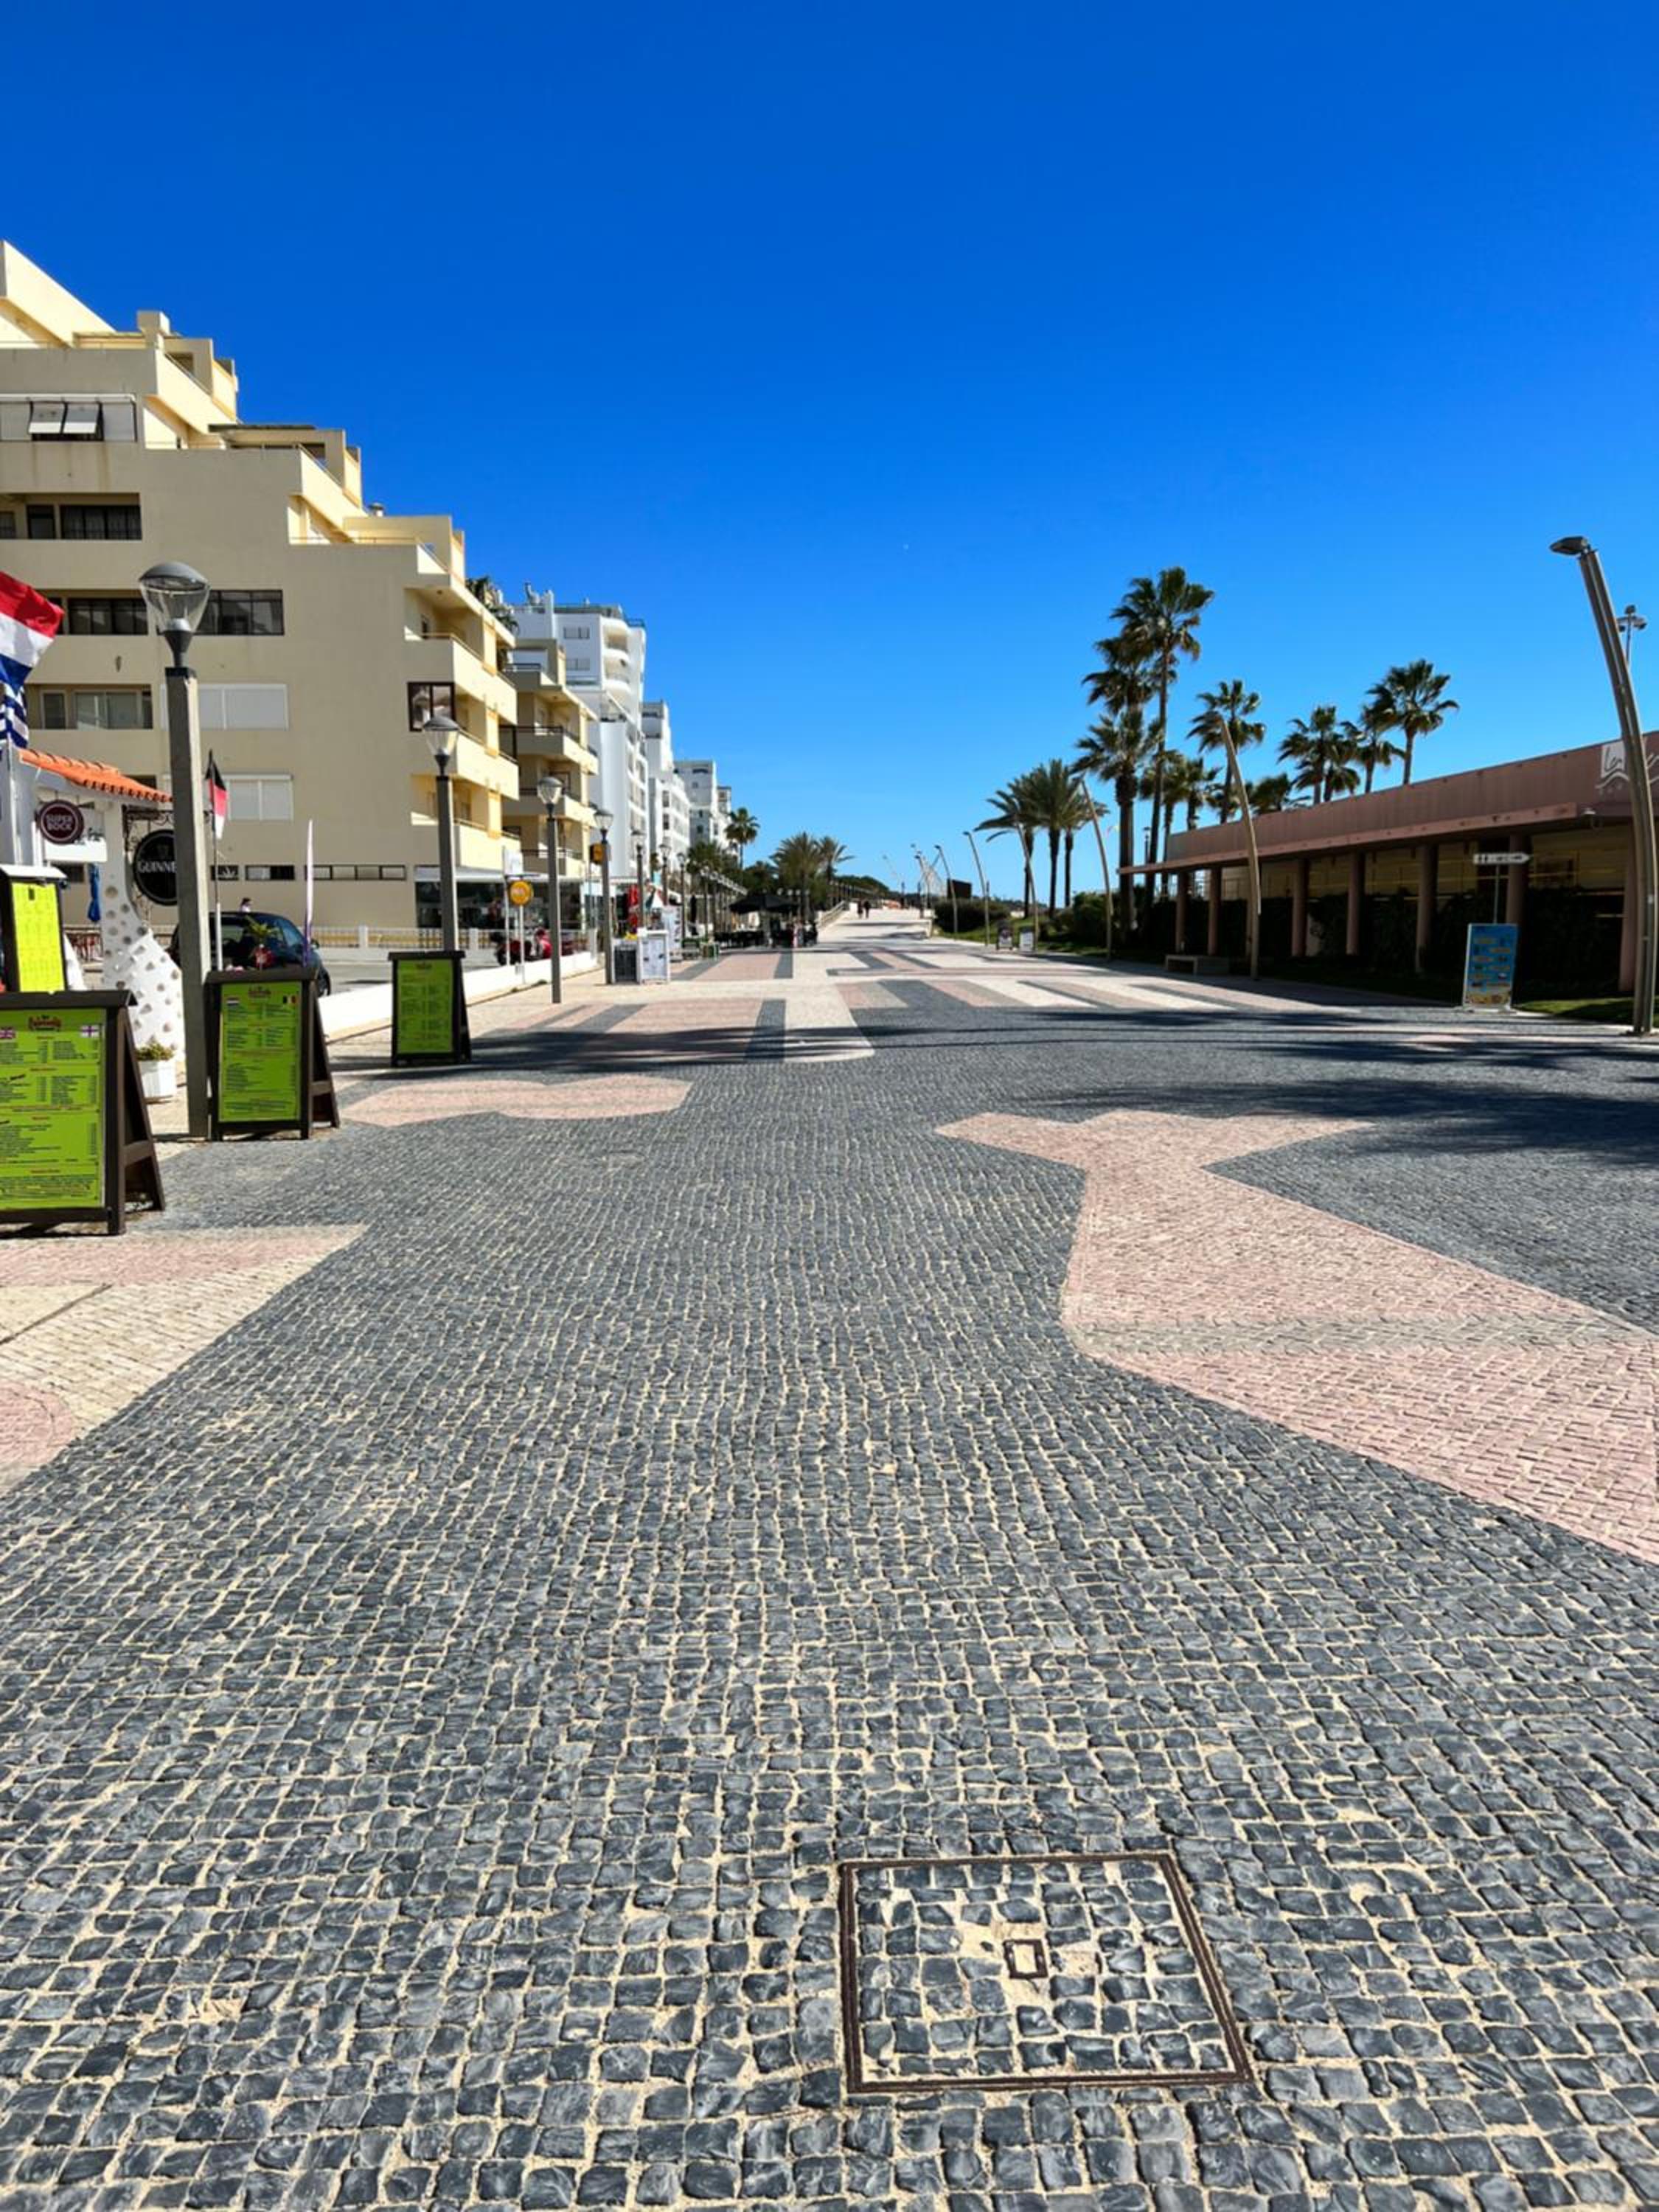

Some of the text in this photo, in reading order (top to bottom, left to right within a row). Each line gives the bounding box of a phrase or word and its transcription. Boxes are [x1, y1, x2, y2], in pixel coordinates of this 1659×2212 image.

[46, 813, 72, 824] SUPER
[46, 822, 73, 832] BOCK
[137, 860, 178, 873] GUINNE
